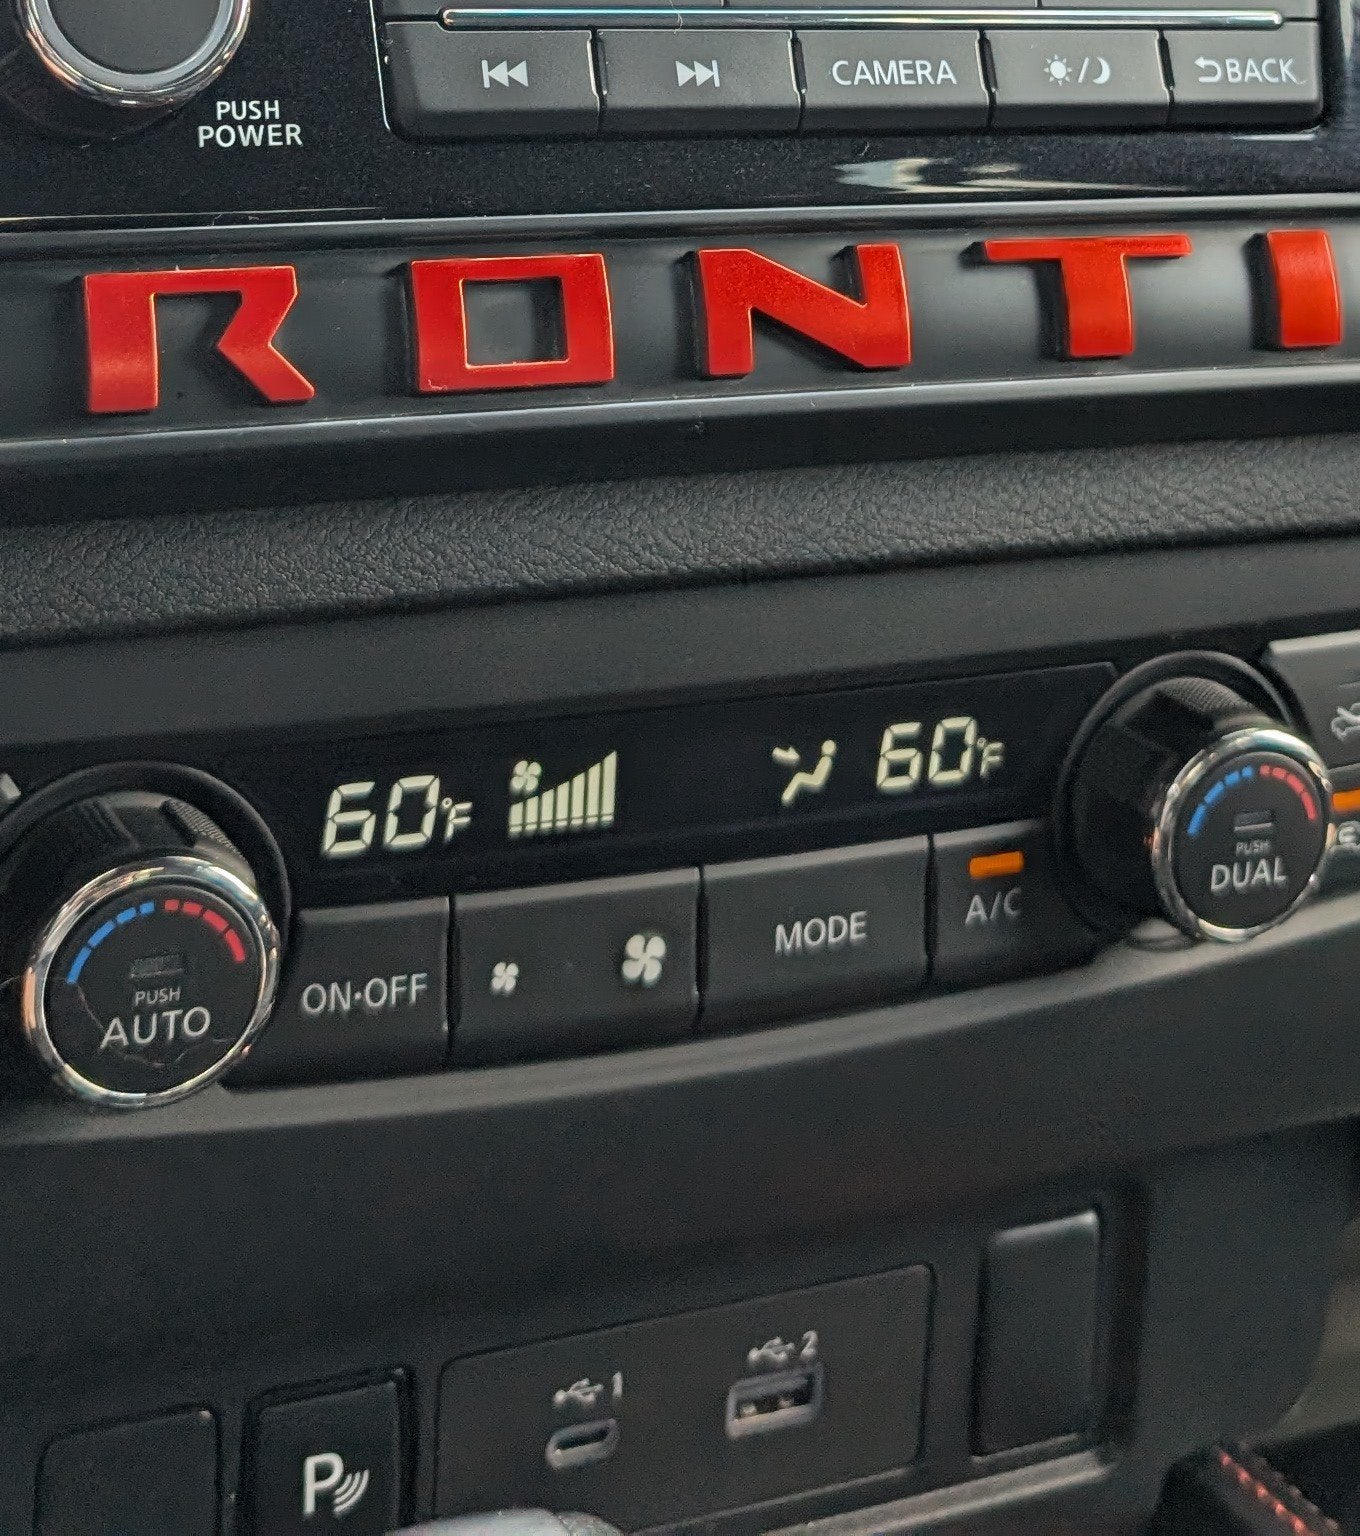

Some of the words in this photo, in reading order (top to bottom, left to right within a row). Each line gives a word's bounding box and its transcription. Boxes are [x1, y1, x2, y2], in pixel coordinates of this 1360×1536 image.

[831, 60, 957, 87] CAMERA
[1226, 57, 1295, 85] BACK
[215, 100, 280, 121] PUSH
[197, 124, 303, 148] POWER
[1210, 857, 1287, 892] DUAL
[965, 888, 1023, 926] A/C
[774, 910, 868, 954] MODE
[134, 987, 181, 1007] PUSH
[100, 1007, 212, 1049] AUTO
